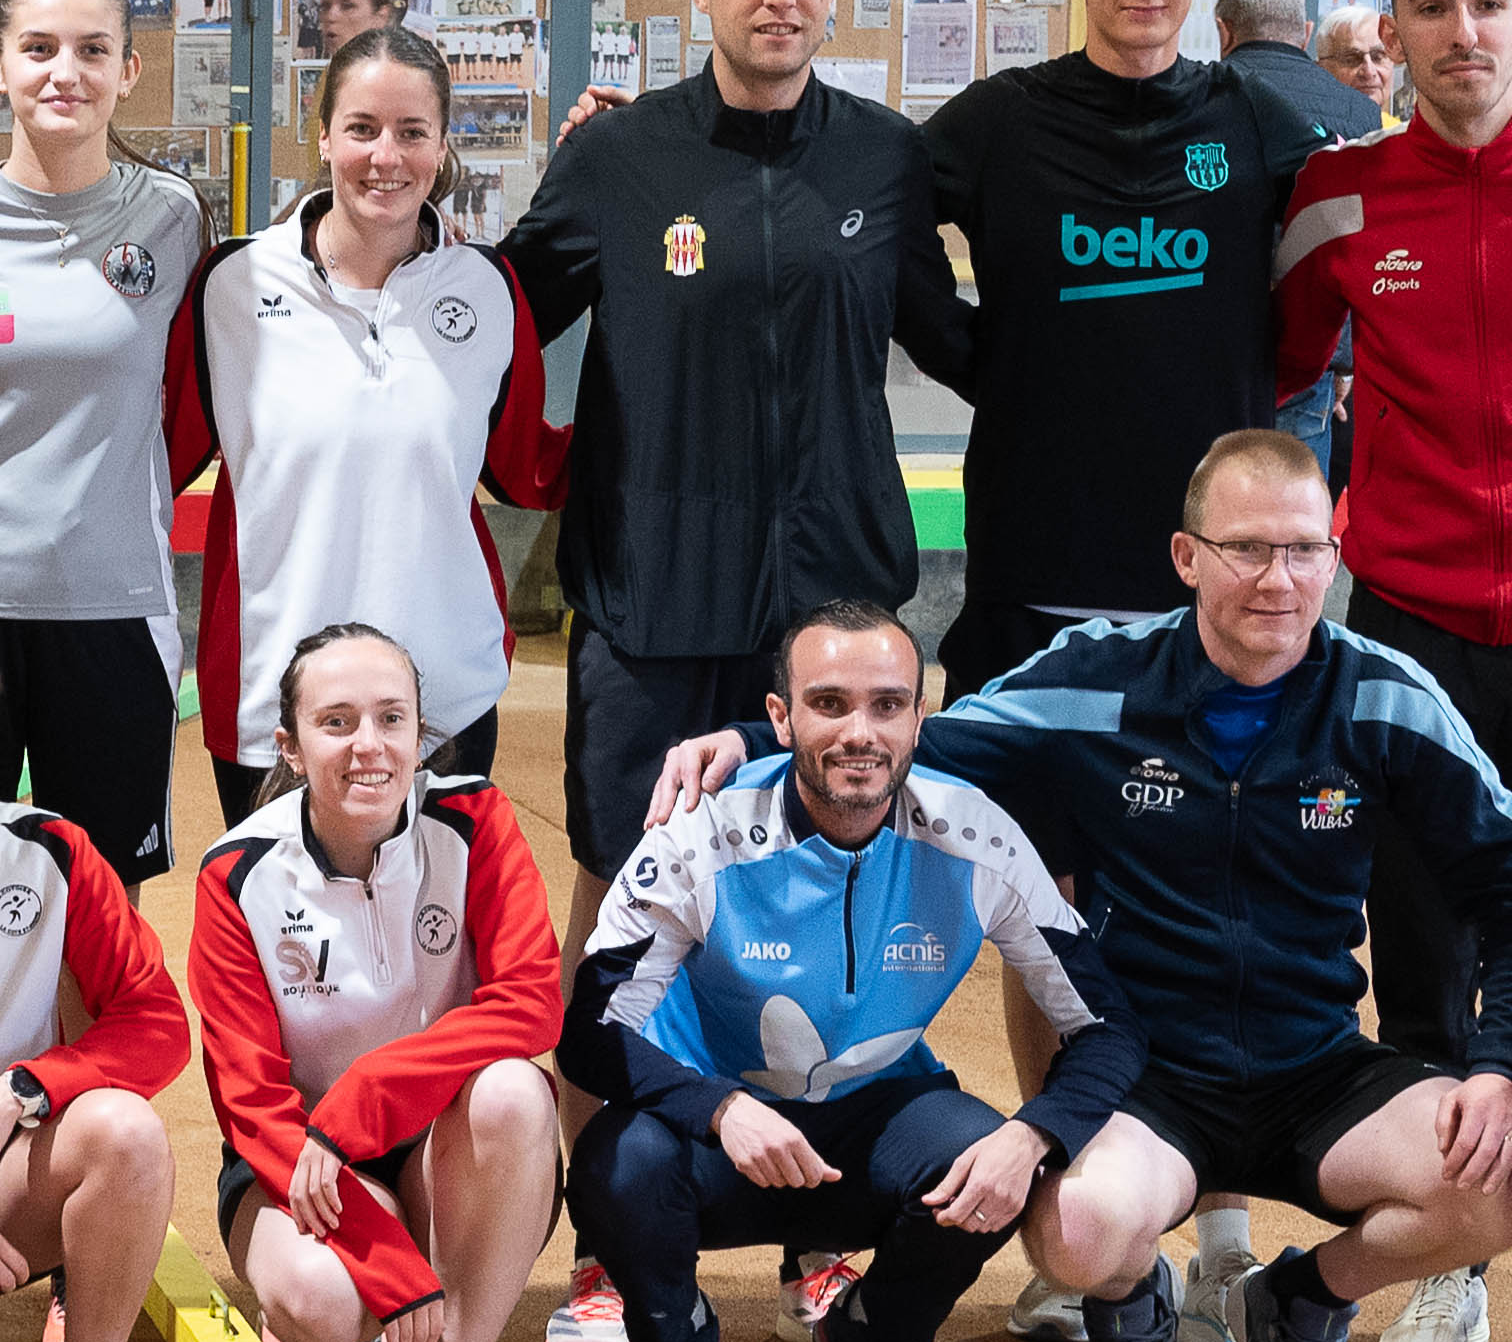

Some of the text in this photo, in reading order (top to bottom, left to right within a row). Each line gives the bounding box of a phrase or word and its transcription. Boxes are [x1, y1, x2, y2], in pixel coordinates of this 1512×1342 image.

[1061, 214, 1209, 269] beko
[1387, 279, 1420, 293] Sports
[1121, 781, 1184, 807] GDP
[280, 923, 314, 935] erima
[741, 941, 791, 961] JAKO
[883, 942, 945, 964] ACNIS
[282, 985, 341, 999] BOUTIQUE
